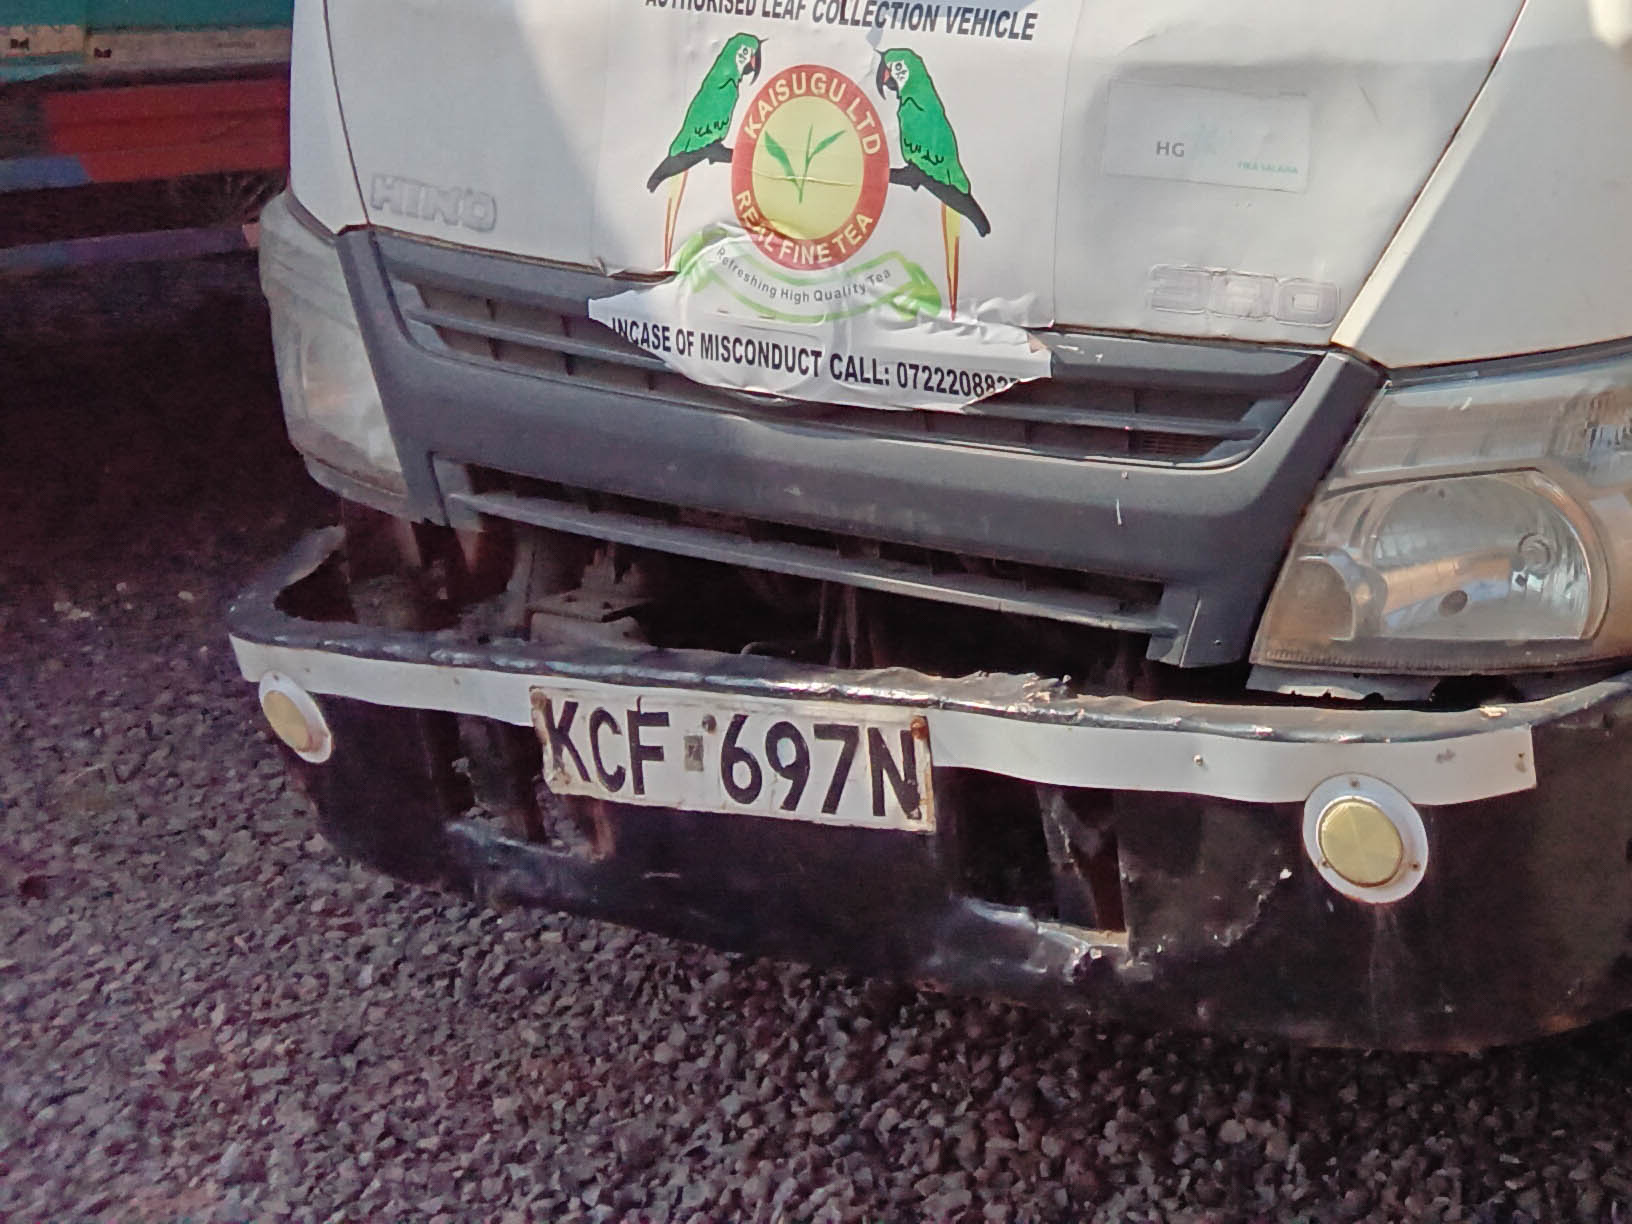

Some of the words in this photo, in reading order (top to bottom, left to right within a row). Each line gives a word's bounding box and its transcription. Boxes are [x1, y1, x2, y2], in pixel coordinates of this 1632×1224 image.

[946, 5, 1038, 41] VEHICLE
[744, 71, 846, 139] KAISUGU
[846, 97, 881, 155] LTD
[370, 173, 498, 233] HINO
[736, 190, 776, 252] REAL
[778, 239, 832, 265] FINE
[832, 213, 874, 255] TEA
[717, 246, 777, 299] Refreshing
[780, 289, 810, 305] High
[813, 282, 866, 302] Quality
[867, 267, 891, 287] Tea
[611, 316, 671, 353] INCASE
[675, 327, 694, 357] OF
[700, 332, 823, 378] MISCONDUCT
[829, 352, 891, 386] CALL:
[896, 361, 1018, 398] 07222088
[546, 696, 669, 795] KCF
[720, 713, 922, 820] 697N
